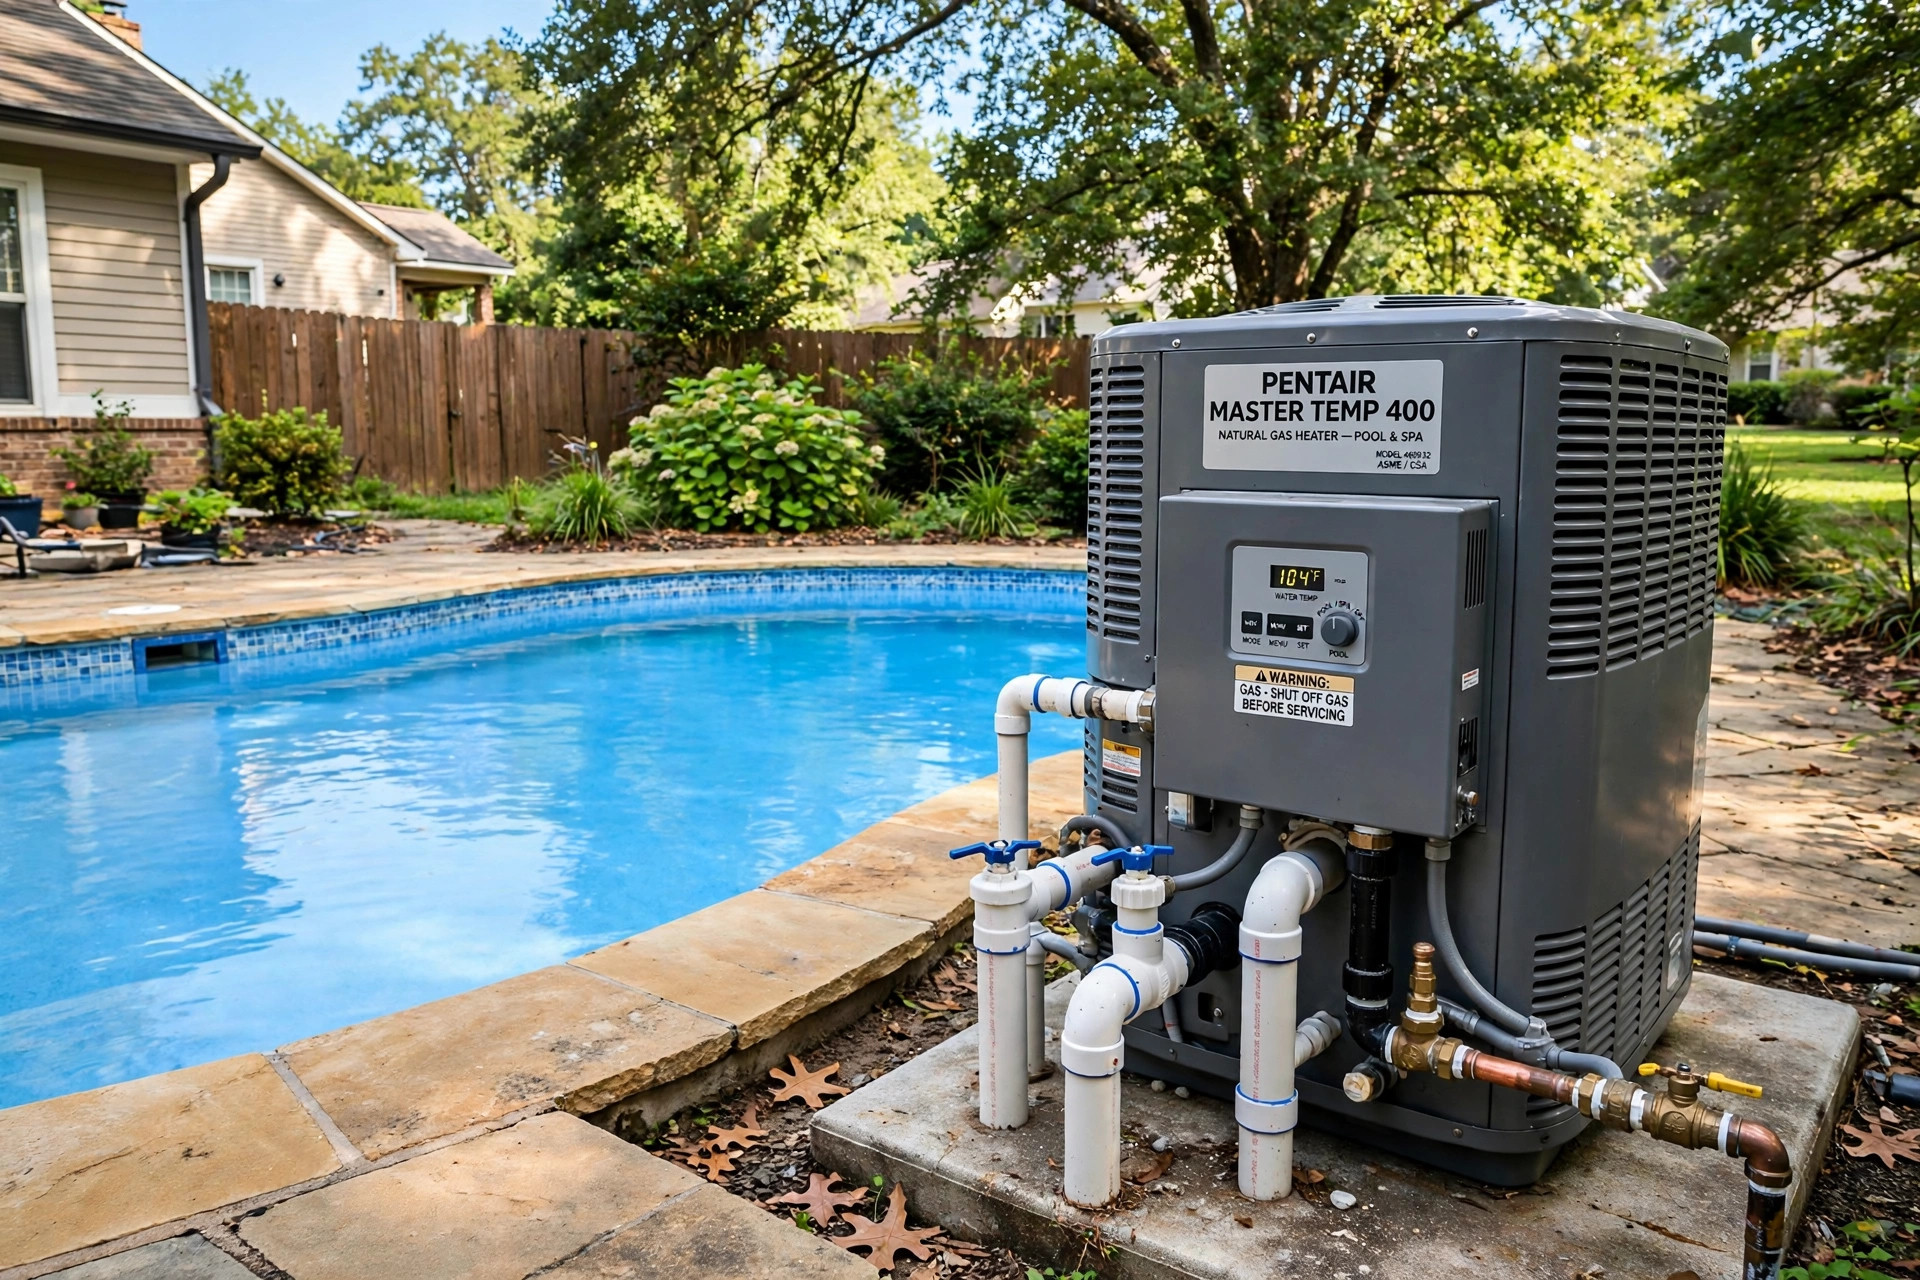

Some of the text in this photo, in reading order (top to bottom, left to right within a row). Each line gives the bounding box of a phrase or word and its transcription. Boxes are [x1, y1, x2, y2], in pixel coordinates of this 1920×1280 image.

[1262, 370, 1376, 395] PENTAIR
[1210, 399, 1435, 422] MASTER TEMP 400
[1219, 430, 1267, 441] NATURAL
[1270, 430, 1292, 441] GAS
[1295, 430, 1338, 442] HEATER
[1354, 431, 1386, 442] POOL
[1389, 431, 1398, 442] &
[1401, 431, 1423, 442] SPA
[1375, 450, 1402, 459] MODEL
[1377, 460, 1427, 470] ASME / CSA
[1275, 592, 1318, 601] WATER TEMP
[1297, 641, 1310, 650] SET
[1328, 649, 1349, 658] POOL
[1269, 671, 1330, 689] WARNING:
[1240, 683, 1261, 697] GAS
[1270, 687, 1299, 702] SHUT
[1302, 691, 1323, 704] OFF
[1325, 694, 1349, 708] GAS
[1242, 698, 1345, 721] BEFORE SERVICING
